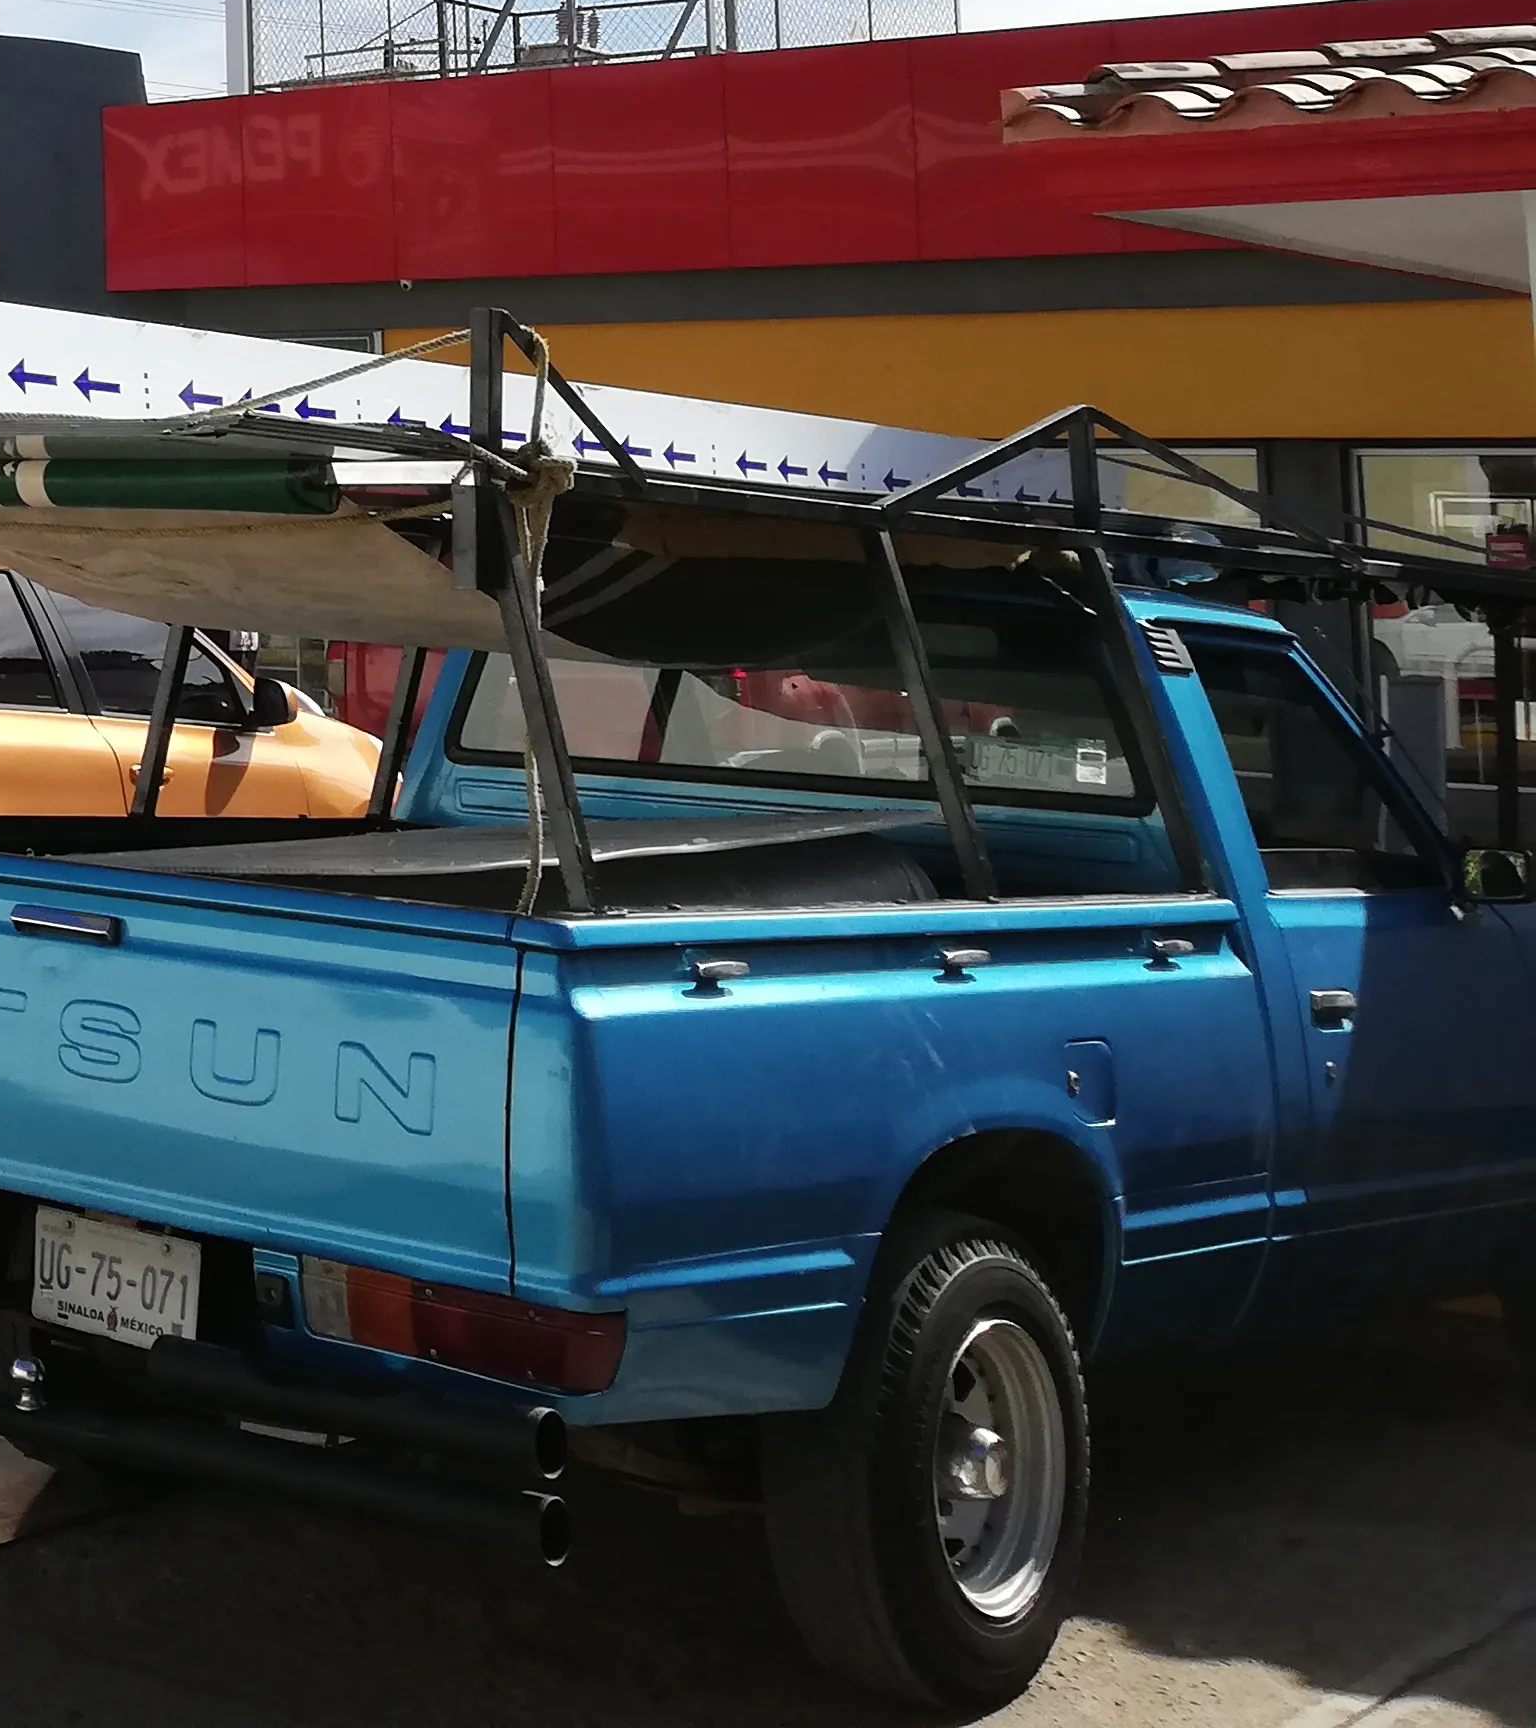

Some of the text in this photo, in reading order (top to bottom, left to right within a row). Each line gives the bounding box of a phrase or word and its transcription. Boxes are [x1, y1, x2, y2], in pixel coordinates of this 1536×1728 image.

[40, 1237, 188, 1321] UG-75-071
[57, 1300, 164, 1337] SINALOA MÉXICO
